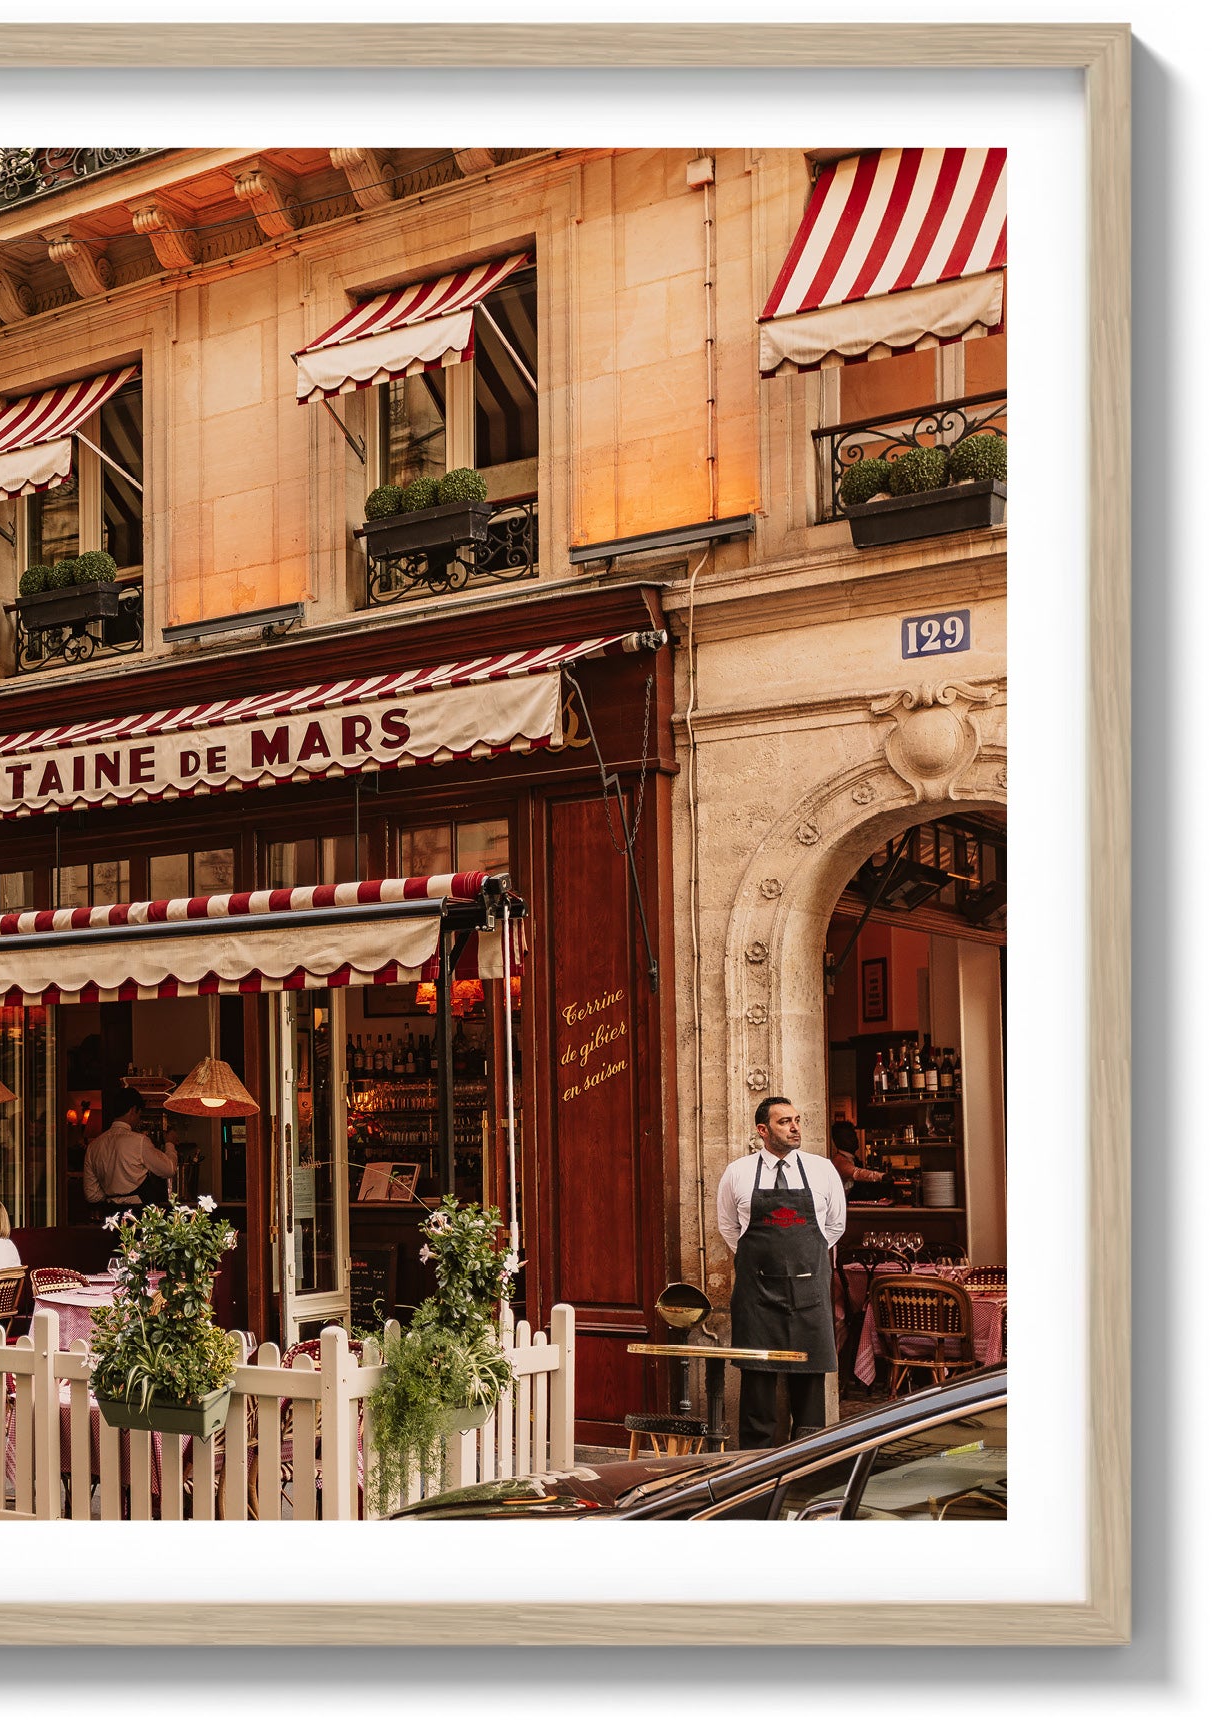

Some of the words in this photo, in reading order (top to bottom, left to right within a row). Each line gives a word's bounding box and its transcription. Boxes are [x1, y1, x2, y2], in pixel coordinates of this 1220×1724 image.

[907, 616, 964, 654] 129
[180, 745, 227, 778] DE
[251, 708, 411, 769] MARS
[562, 989, 625, 1026] Terrine
[561, 1044, 578, 1066] de
[579, 1021, 628, 1067] gibier
[562, 1084, 581, 1102] en
[583, 1060, 628, 1091] saison
